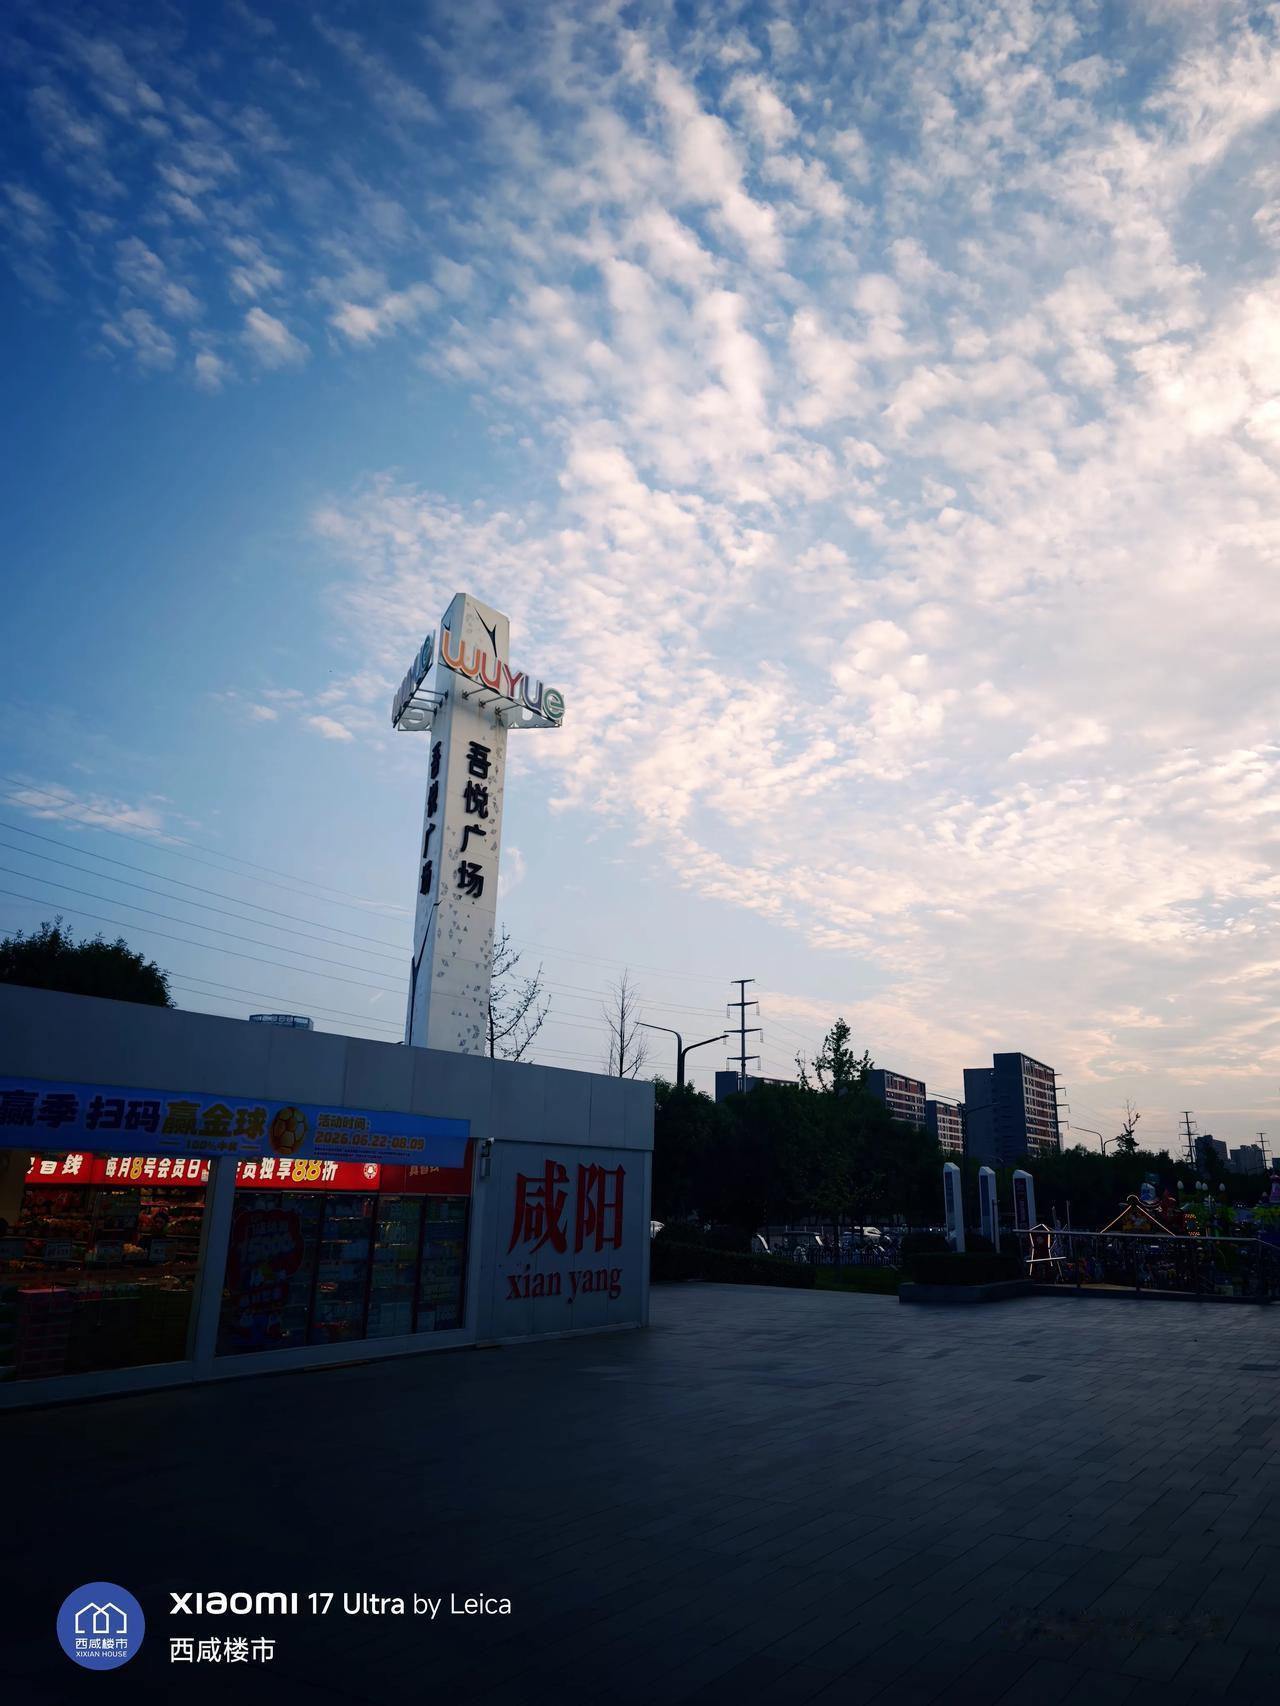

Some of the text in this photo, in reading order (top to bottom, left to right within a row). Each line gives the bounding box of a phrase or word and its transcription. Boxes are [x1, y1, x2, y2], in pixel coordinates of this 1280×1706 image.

[457, 741, 492, 899] 吾悦广场
[105, 1156, 338, 1182] 每月8号会员日 员独享8.8折
[506, 1159, 626, 1254] 咸阳
[506, 1264, 622, 1304] xian yang
